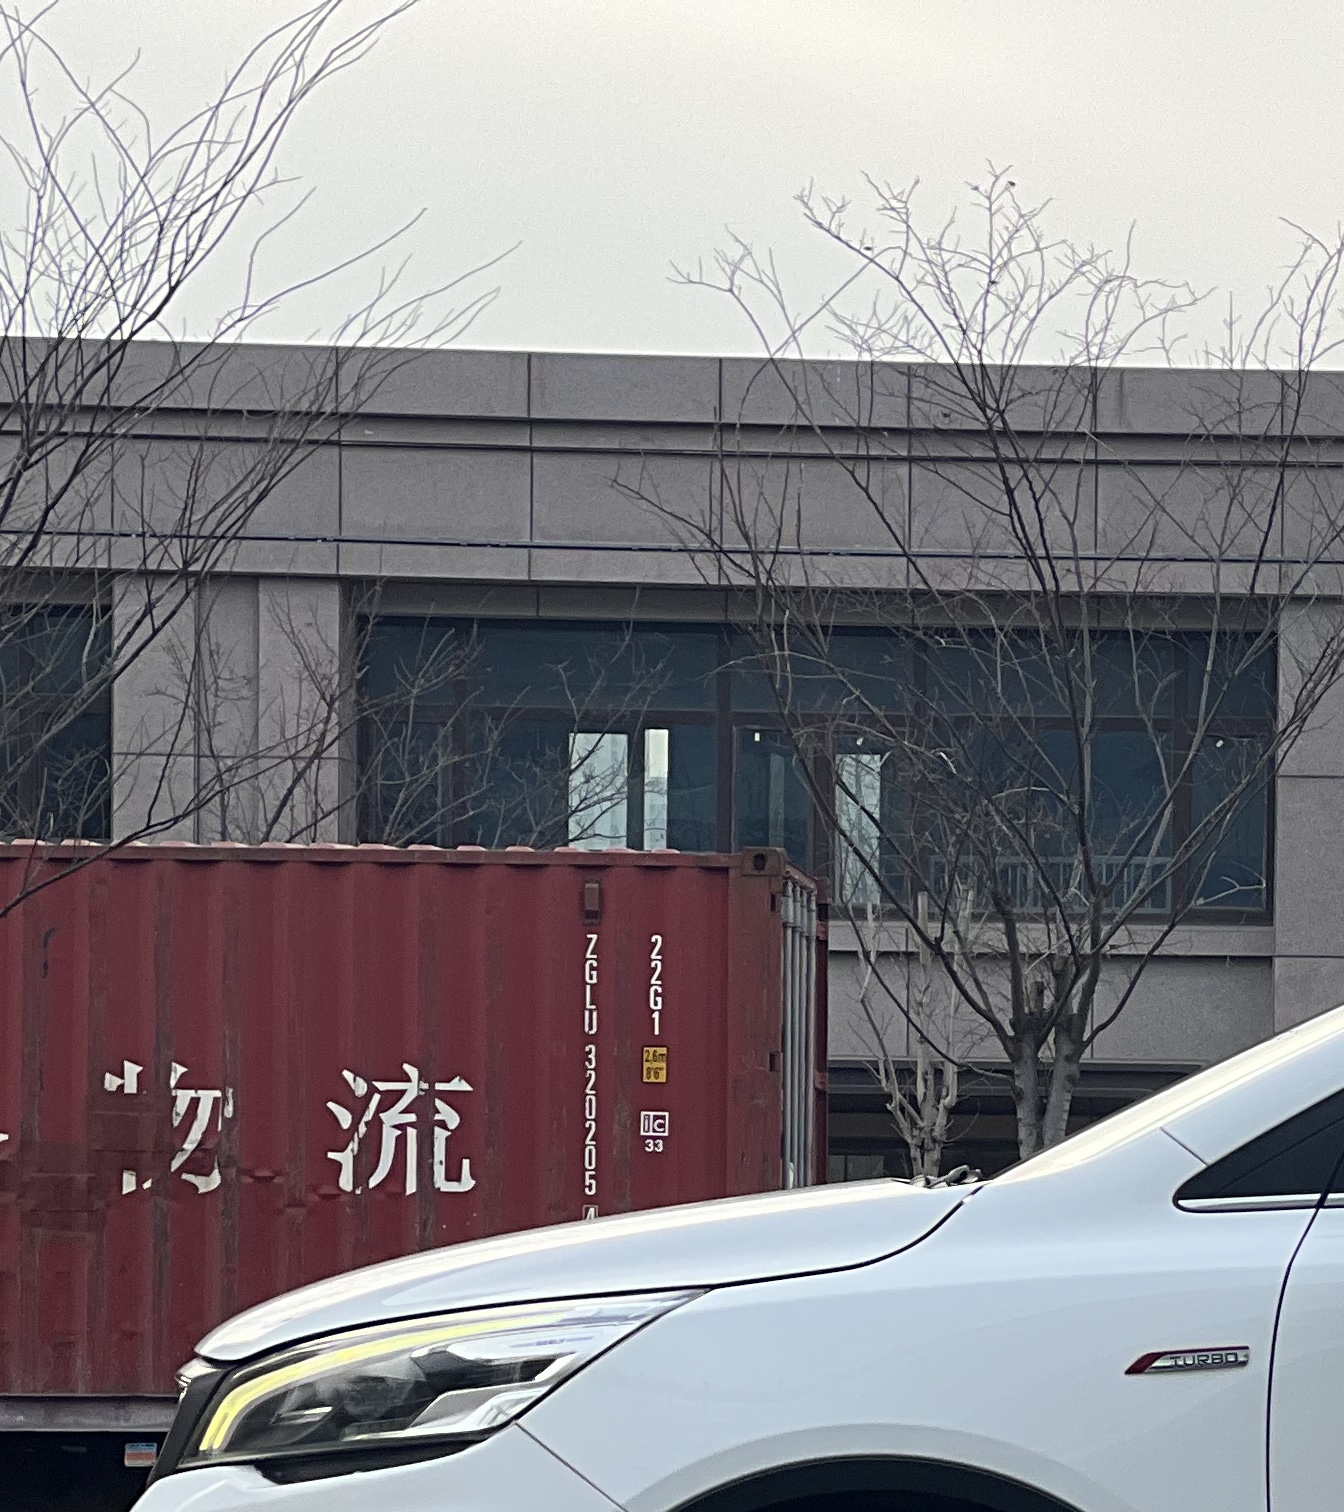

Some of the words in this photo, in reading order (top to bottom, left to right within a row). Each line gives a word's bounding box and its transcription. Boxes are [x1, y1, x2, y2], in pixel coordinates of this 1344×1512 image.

[583, 933, 599, 1035] ZGLU
[649, 934, 663, 1036] 22G1
[0, 1060, 477, 1196] 物流
[584, 1043, 598, 1196] 320205
[644, 1139, 664, 1153] 33
[1169, 1351, 1239, 1367] TURBO
